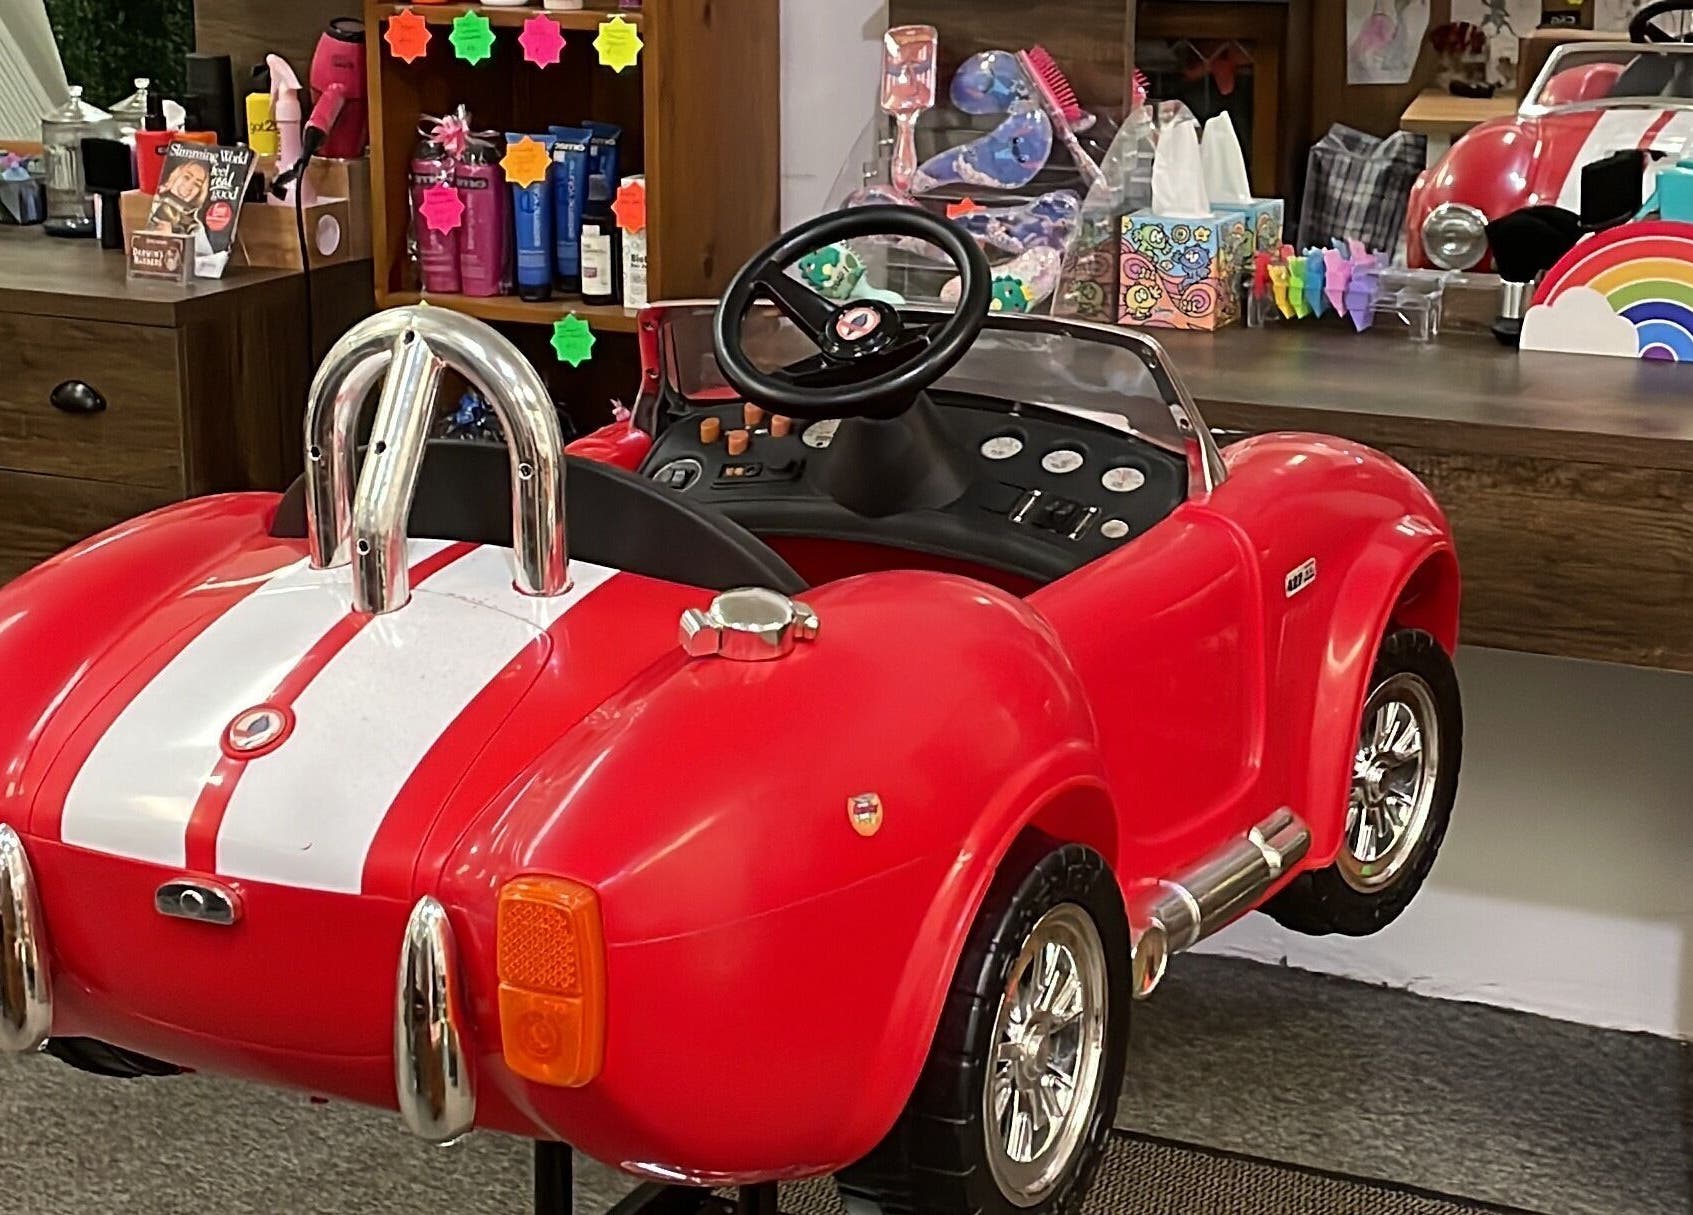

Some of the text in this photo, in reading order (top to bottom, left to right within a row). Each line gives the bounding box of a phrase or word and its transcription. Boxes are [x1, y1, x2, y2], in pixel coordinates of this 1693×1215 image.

[170, 143, 249, 166] Slimming World
[211, 164, 230, 177] feel
[210, 171, 235, 187] real
[211, 187, 239, 200] good
